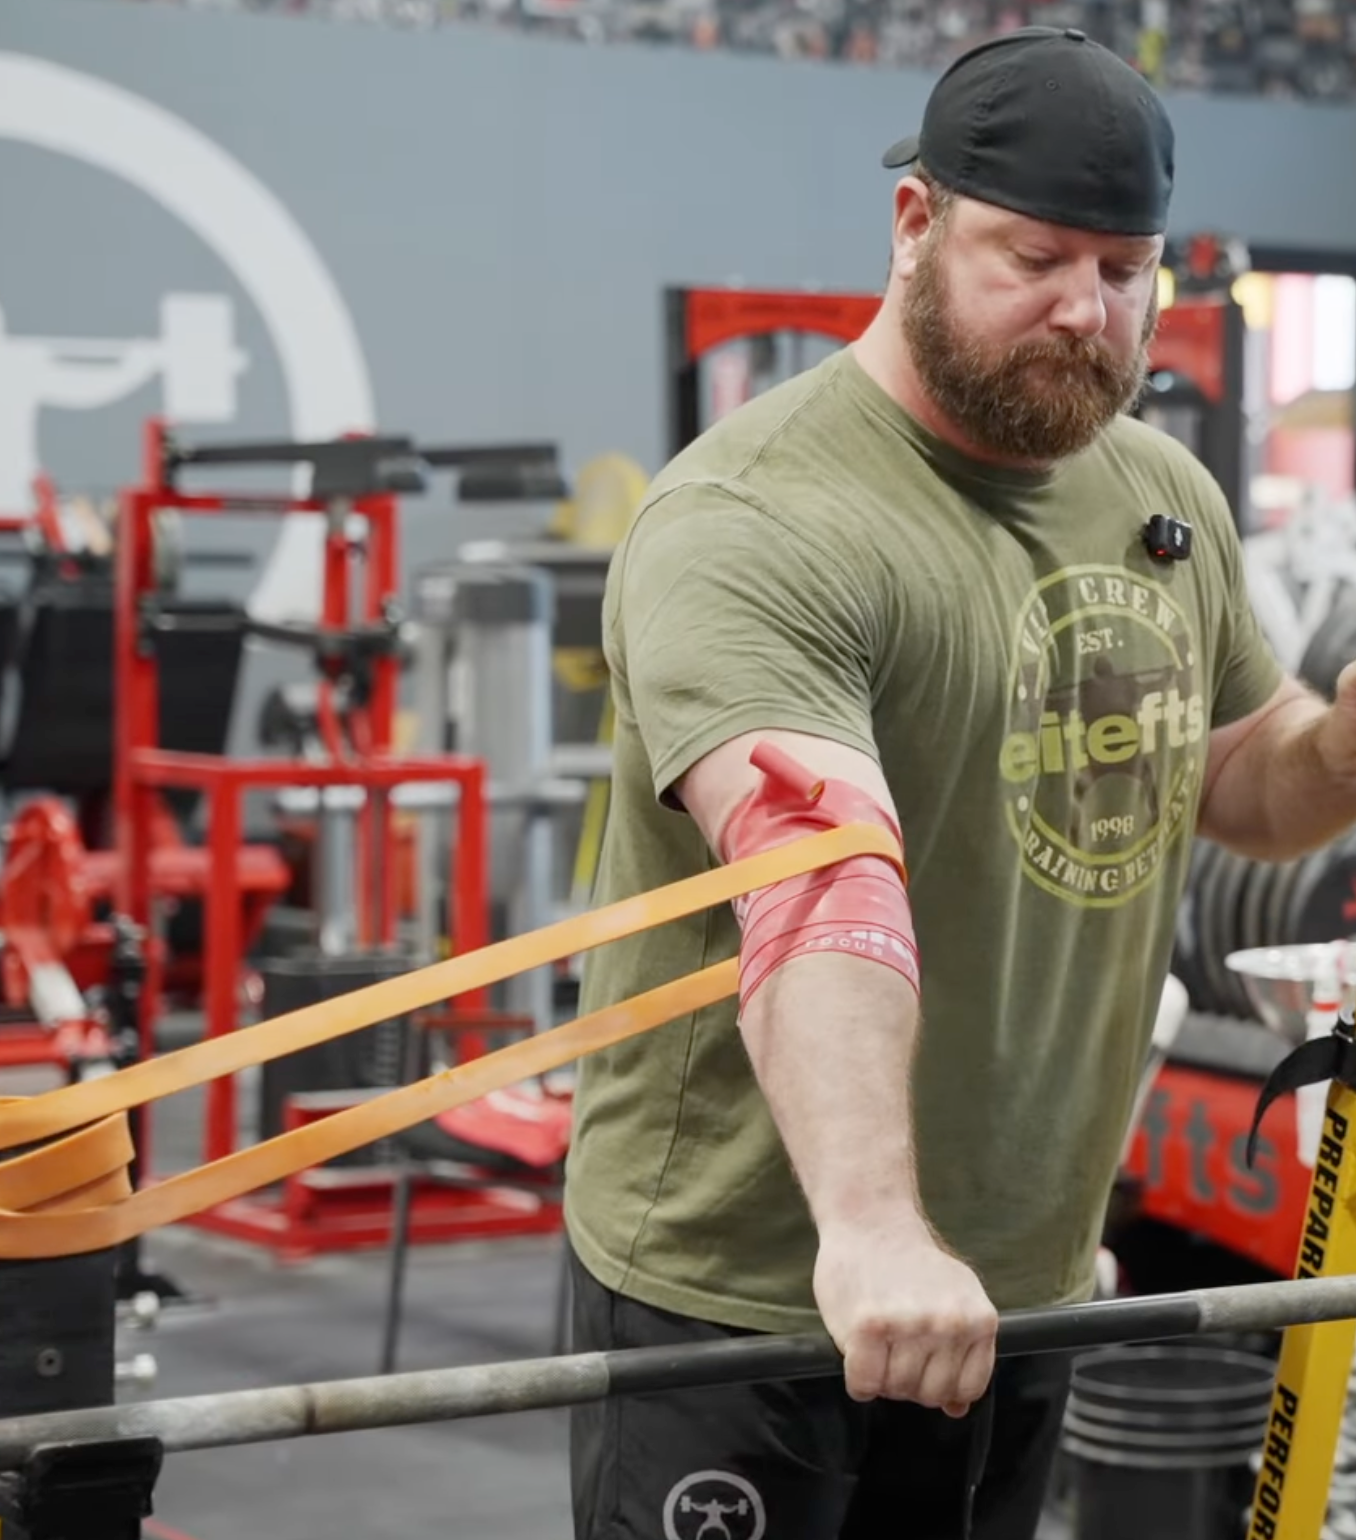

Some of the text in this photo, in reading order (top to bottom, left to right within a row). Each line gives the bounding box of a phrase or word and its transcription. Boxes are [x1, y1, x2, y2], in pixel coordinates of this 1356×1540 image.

[1079, 576, 1176, 632] CREW
[1076, 627, 1125, 655] EST.
[1000, 689, 1204, 783] eitefts
[1090, 814, 1135, 842] 1998
[1023, 829, 1119, 892] RAINING
[1250, 1383, 1299, 1540] PERFOR
